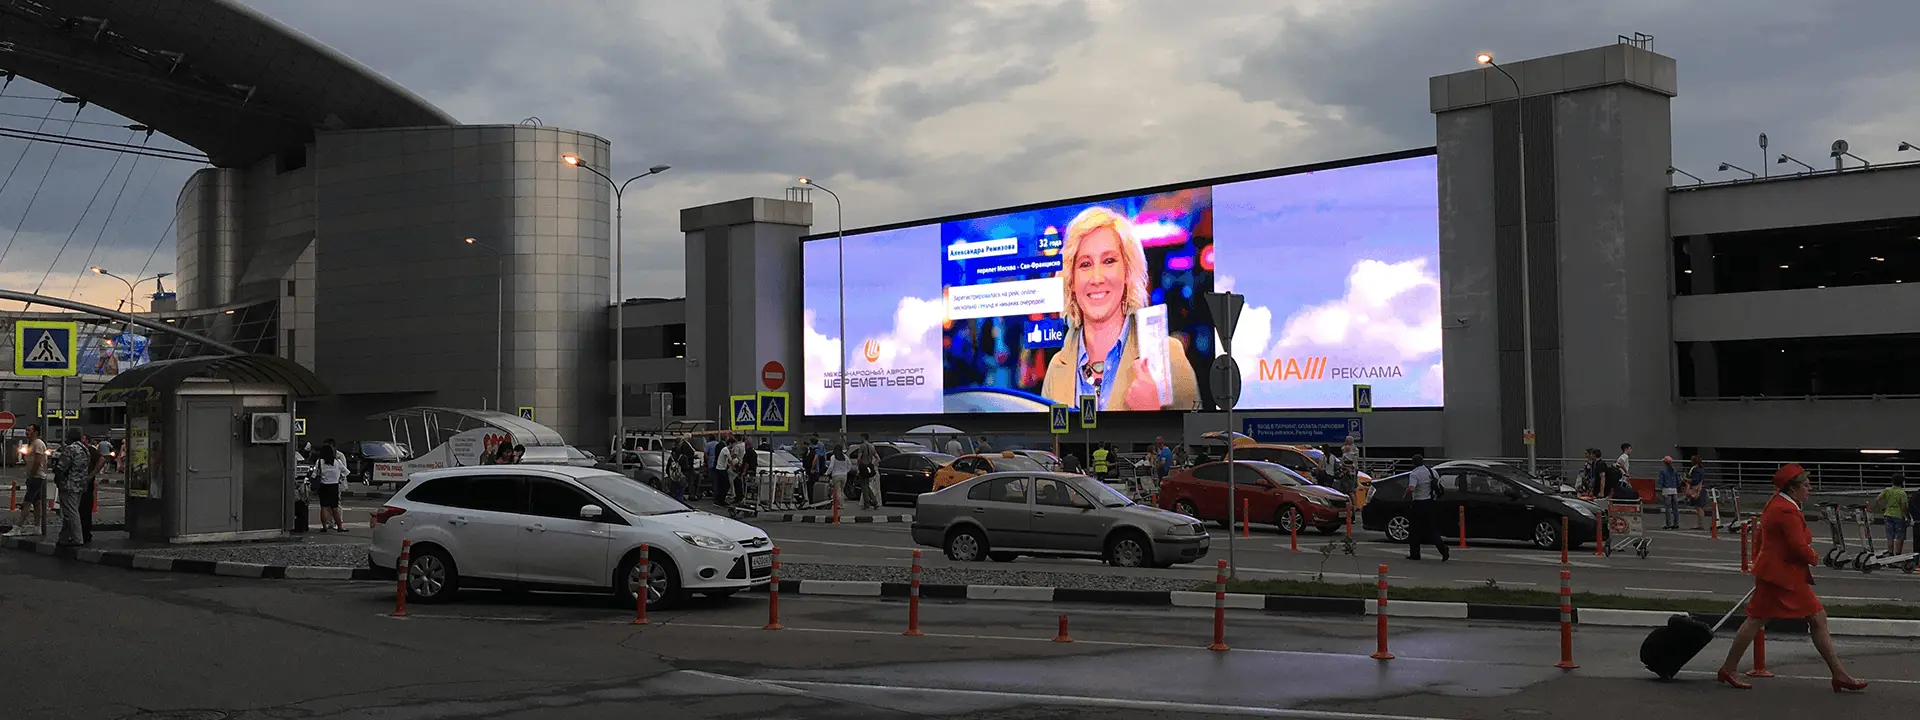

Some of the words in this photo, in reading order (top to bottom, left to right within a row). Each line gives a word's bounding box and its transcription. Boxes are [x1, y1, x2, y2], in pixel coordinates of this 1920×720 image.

[1039, 239, 1048, 248] 32
[1049, 240, 1062, 248] года
[950, 248, 984, 257] Александра
[986, 244, 1015, 253] Ремизова
[997, 264, 1016, 272] Москва
[1020, 260, 1061, 270] Сан-Франциско
[1044, 328, 1062, 341] Like
[886, 367, 925, 375] АЭРОПОРТ
[1332, 366, 1402, 379] РЕКЛАМА
[824, 375, 925, 389] ШЕРЕМЕТЬЕВО
